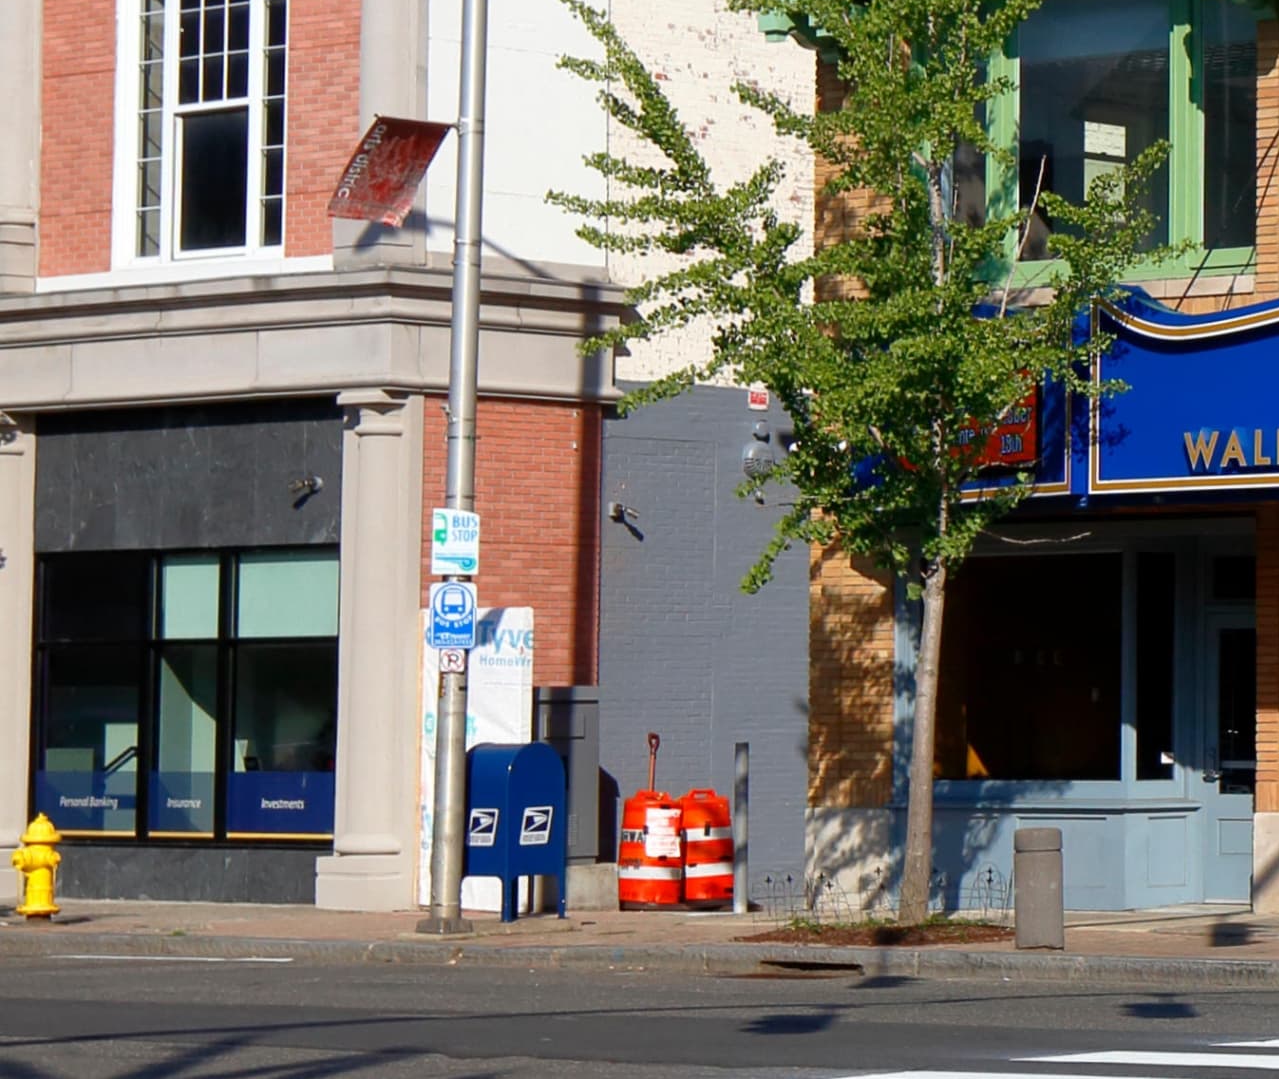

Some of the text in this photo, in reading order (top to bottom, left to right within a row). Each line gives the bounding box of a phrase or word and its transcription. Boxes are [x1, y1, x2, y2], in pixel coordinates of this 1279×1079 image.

[338, 153, 369, 199] distric
[452, 515, 478, 528] BUS
[452, 529, 478, 543] STOP
[166, 797, 202, 809] Insurance
[261, 797, 305, 810] Investments
